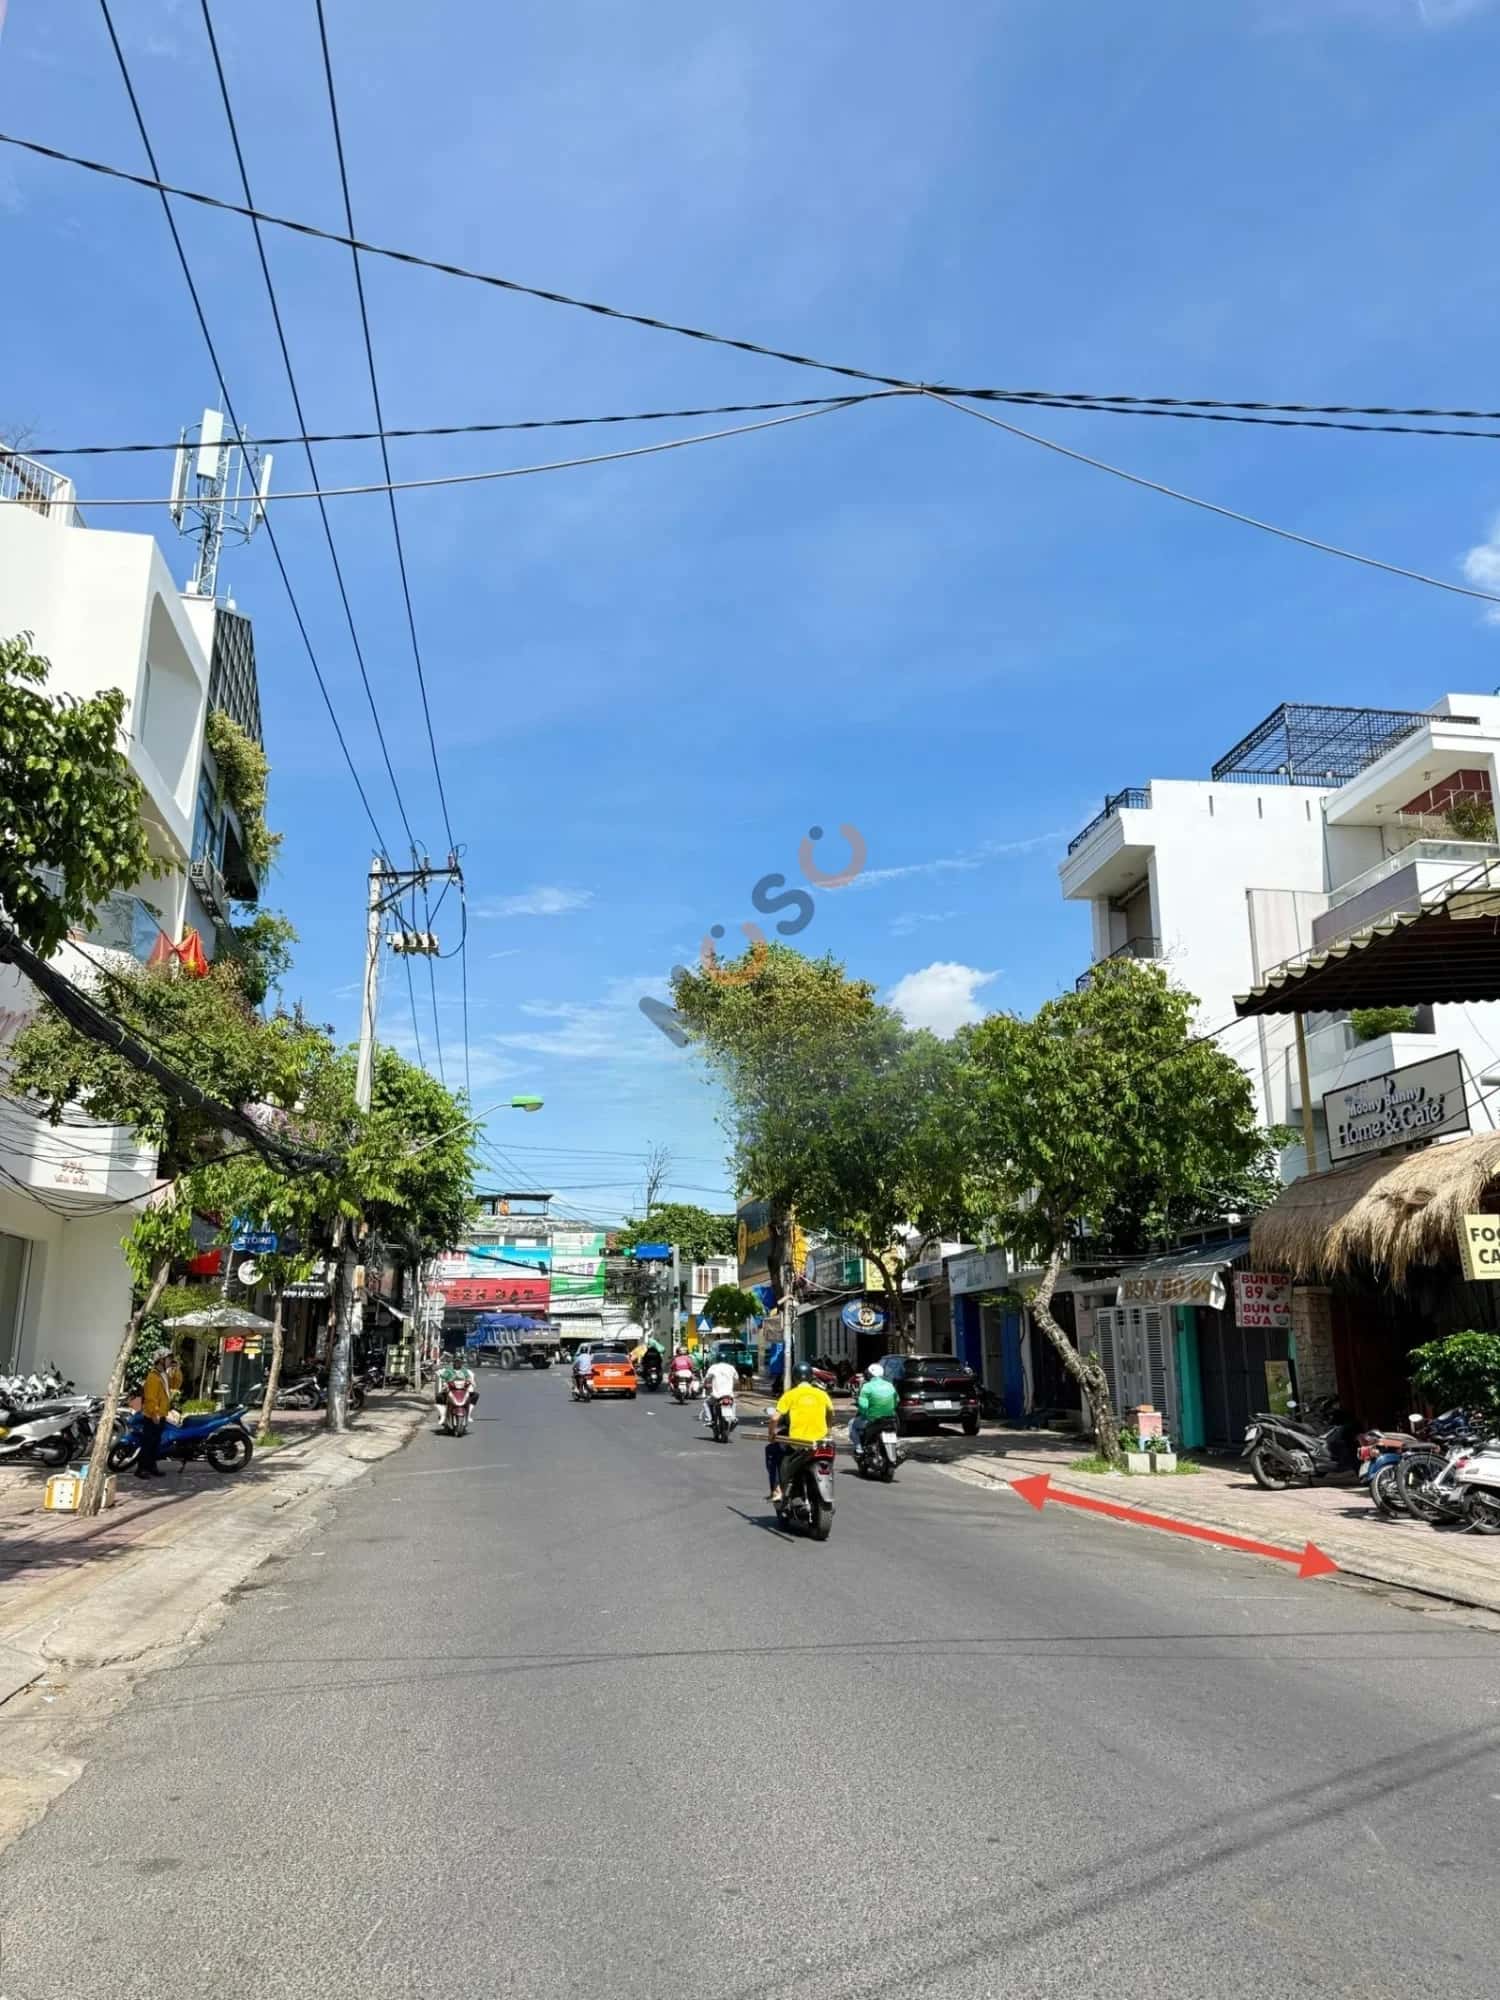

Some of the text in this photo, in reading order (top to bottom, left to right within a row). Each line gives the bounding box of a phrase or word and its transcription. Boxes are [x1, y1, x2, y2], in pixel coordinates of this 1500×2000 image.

[1339, 1119, 1383, 1146] Home
[1383, 1108, 1400, 1133] &
[238, 1234, 272, 1245] STORE
[1470, 1227, 1500, 1242] FO
[1245, 1285, 1264, 1299] 89
[1243, 1300, 1270, 1313] BÚN
